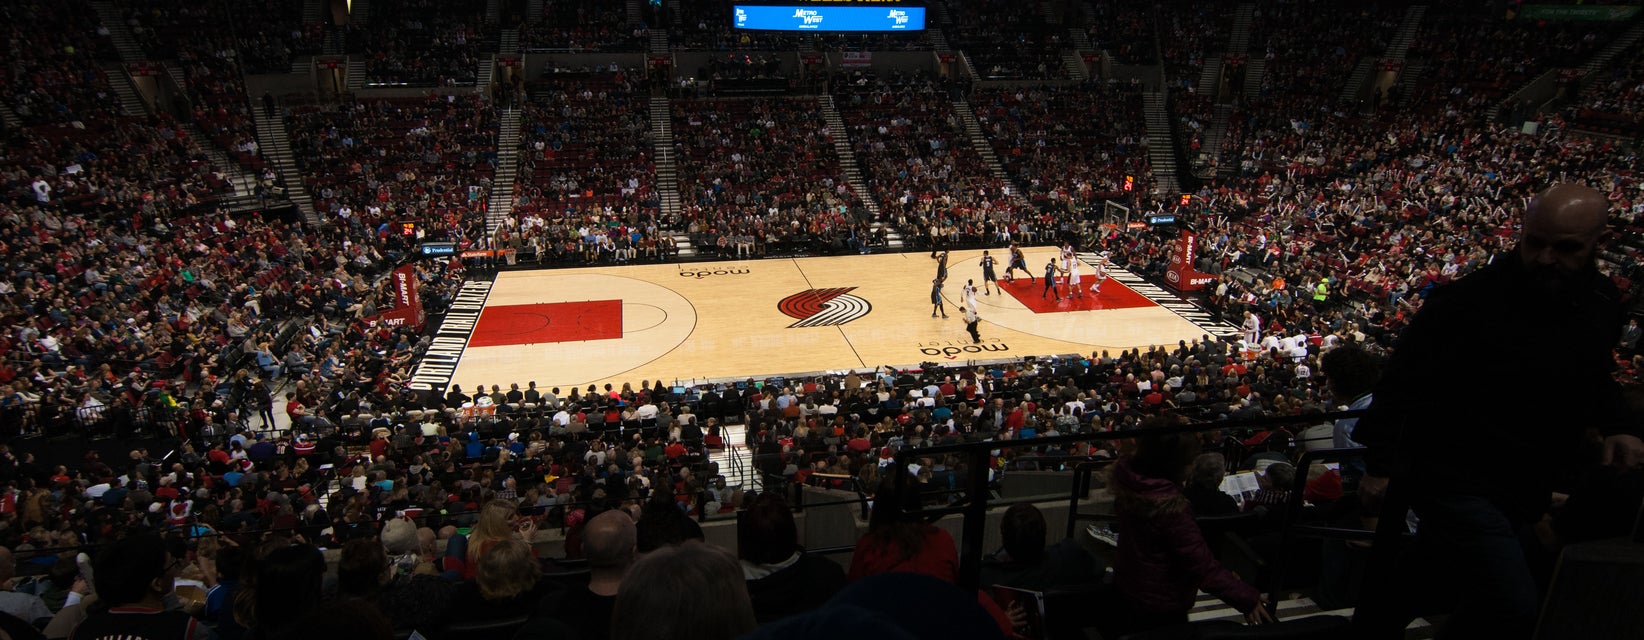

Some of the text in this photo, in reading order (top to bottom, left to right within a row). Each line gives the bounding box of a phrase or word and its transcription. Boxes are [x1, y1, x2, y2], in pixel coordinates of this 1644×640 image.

[680, 269, 750, 277] moda
[398, 272, 410, 306] BI-MART
[437, 311, 479, 334] TRAIL
[920, 343, 1009, 356] moda
